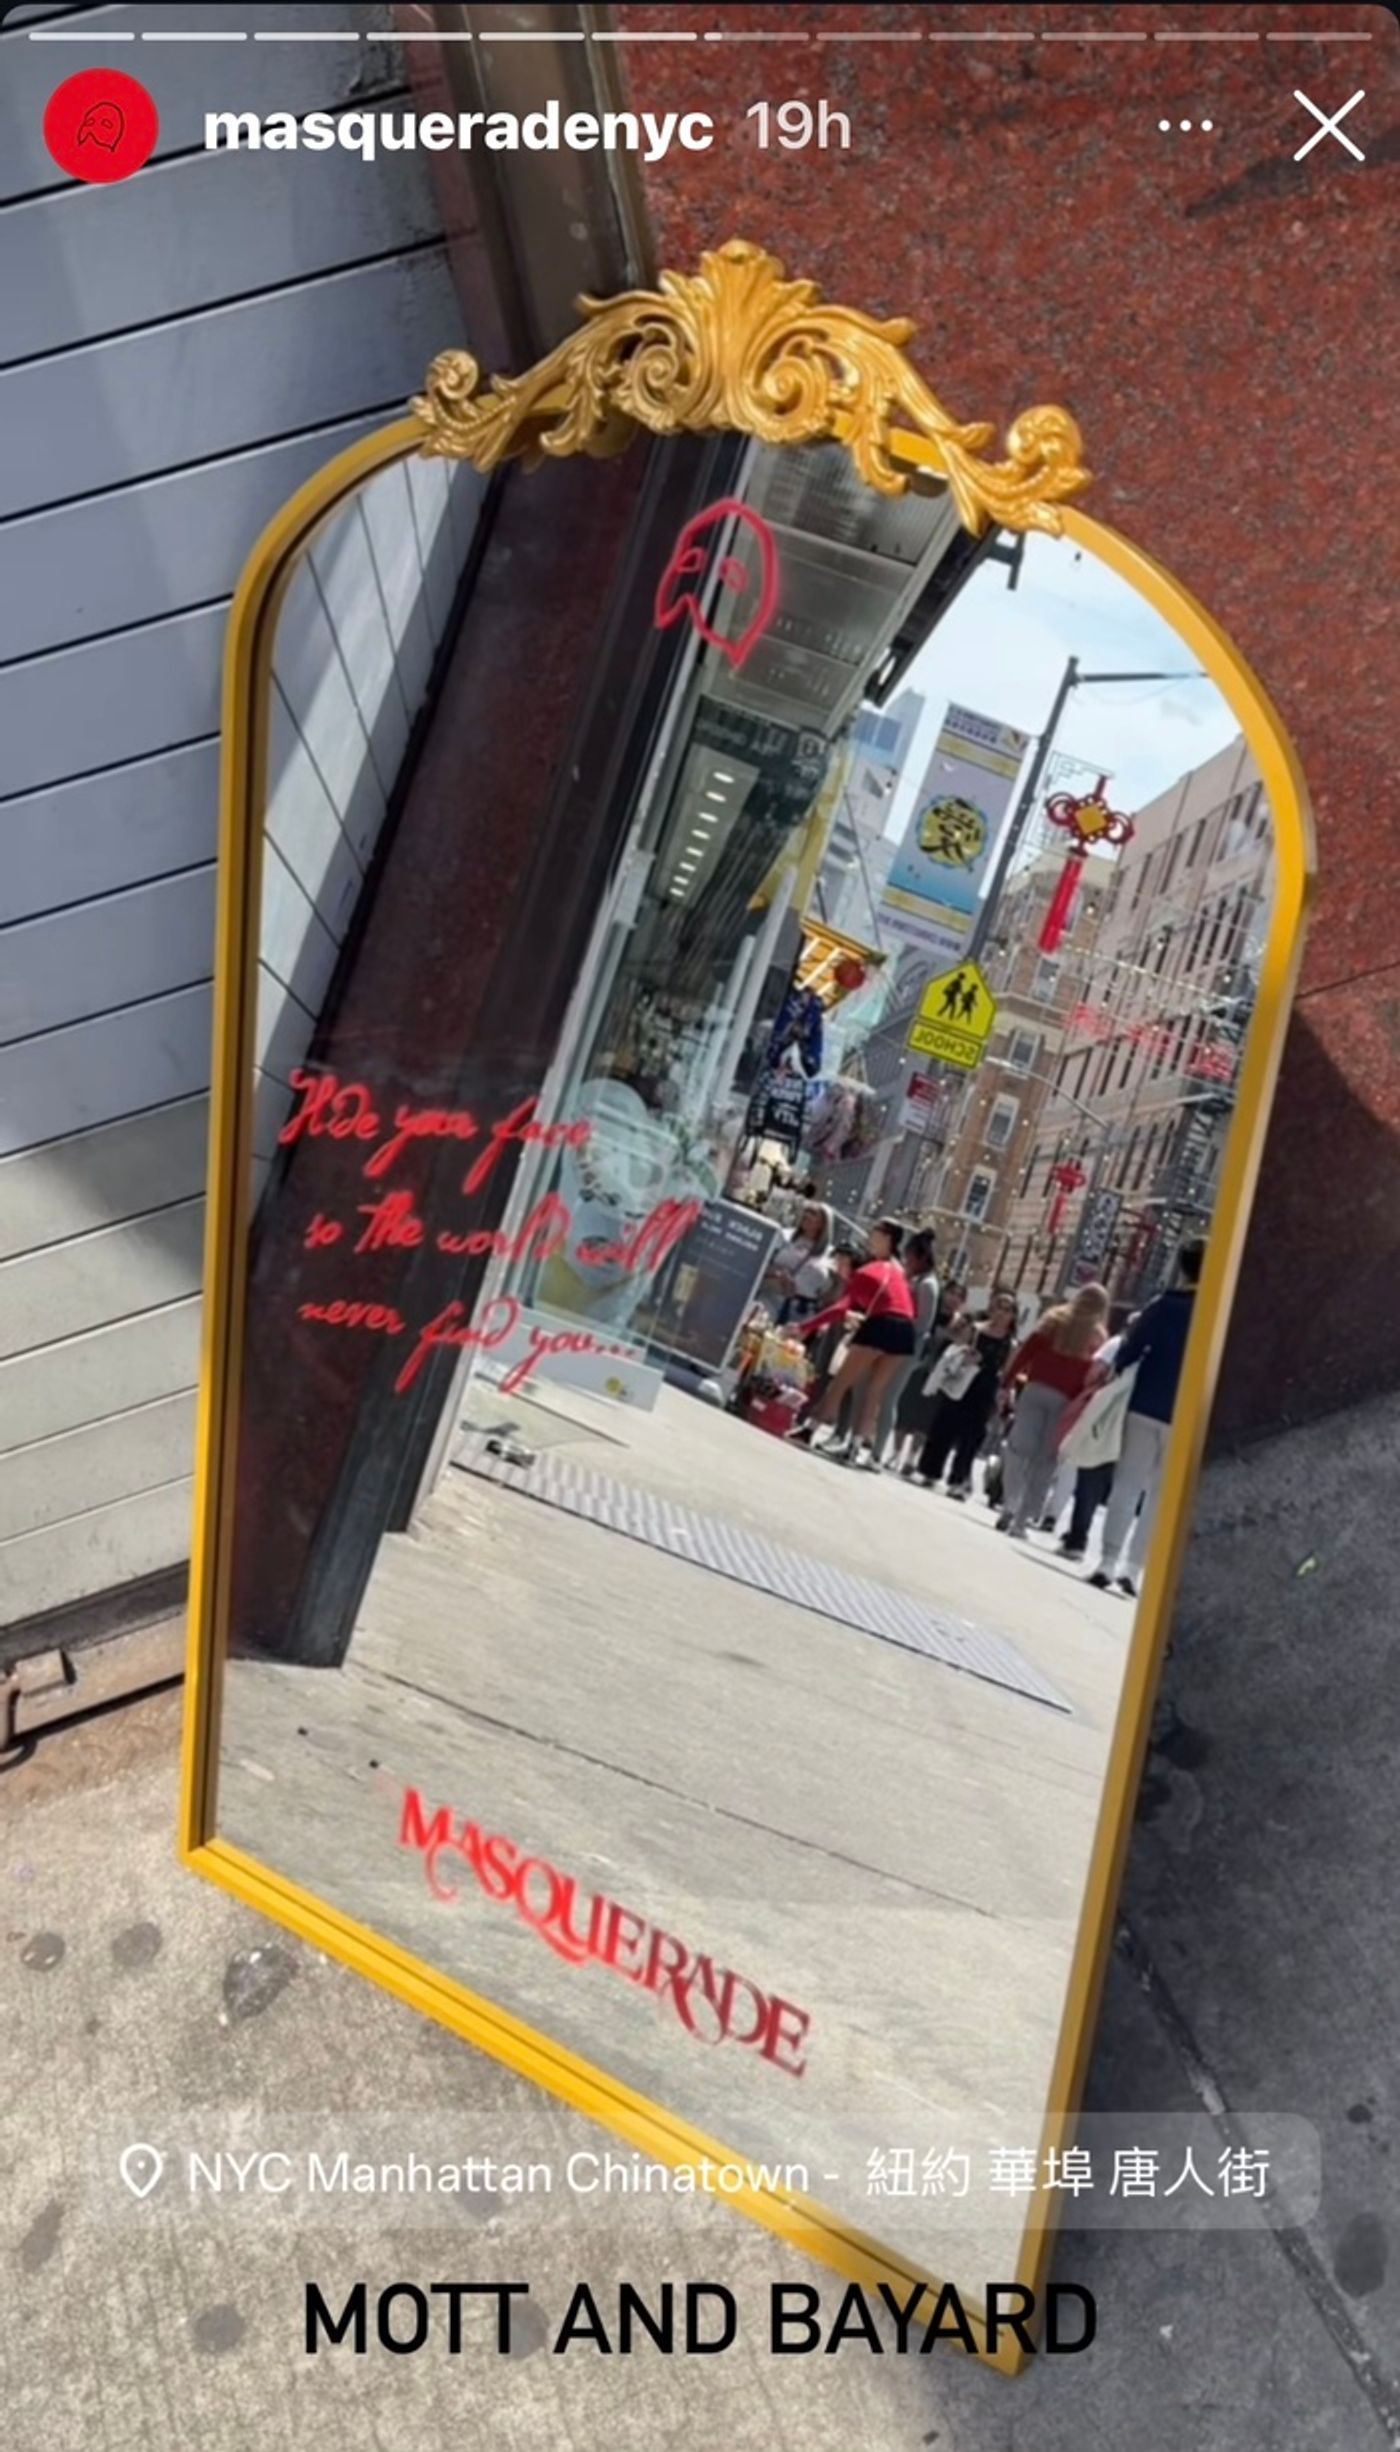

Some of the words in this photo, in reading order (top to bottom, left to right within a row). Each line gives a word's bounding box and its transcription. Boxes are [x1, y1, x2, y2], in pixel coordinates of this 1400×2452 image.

[363, 1103, 479, 1179] your
[462, 1096, 592, 1194] face
[304, 1213, 344, 1249] so
[436, 1190, 572, 1264] world
[575, 1194, 702, 1275] will
[298, 1300, 406, 1335] never
[394, 1297, 523, 1393] find
[398, 1784, 812, 2080] MASQUERADE
